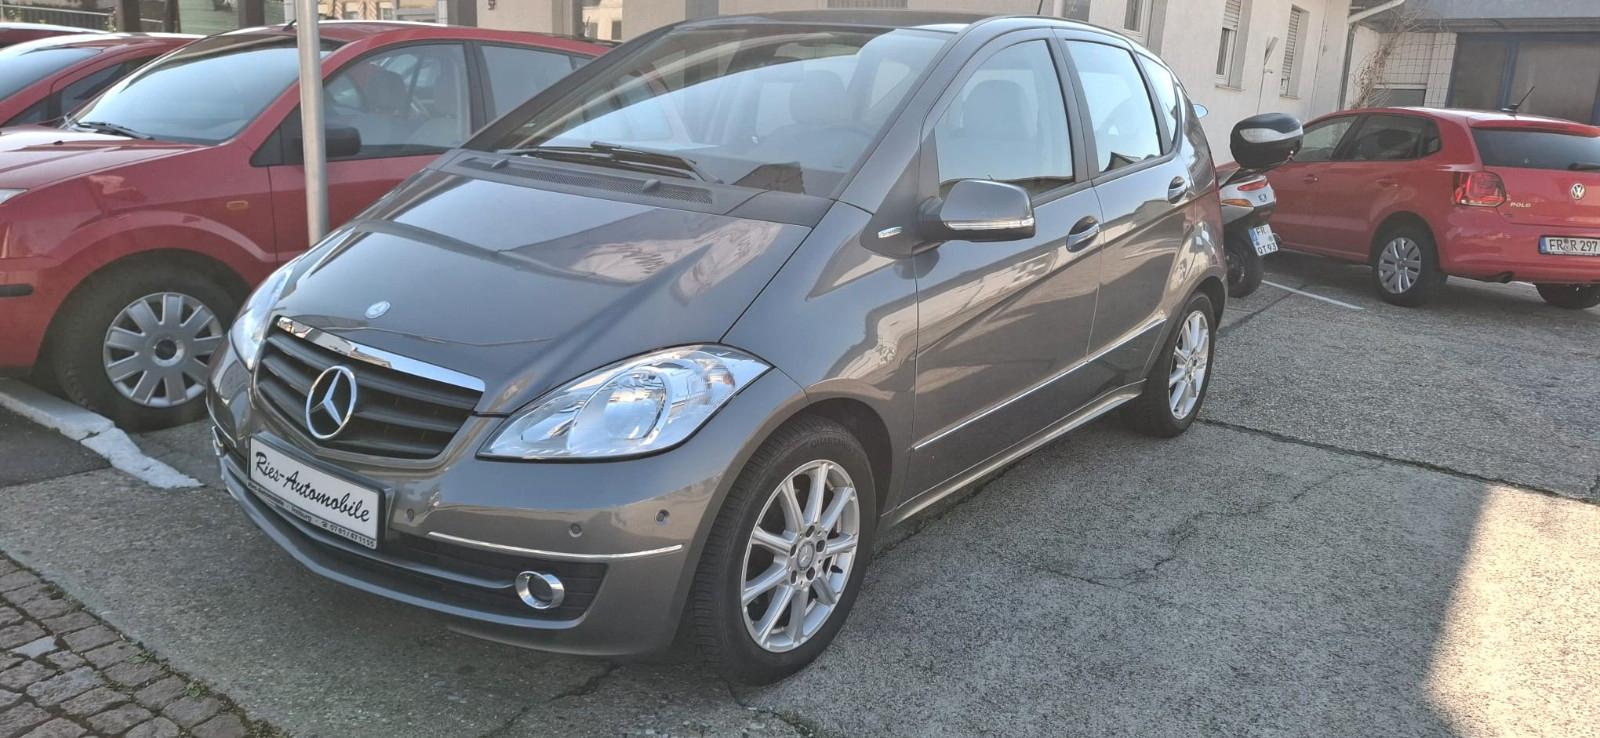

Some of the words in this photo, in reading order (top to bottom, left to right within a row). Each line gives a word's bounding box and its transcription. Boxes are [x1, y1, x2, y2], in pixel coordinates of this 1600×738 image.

[1256, 226, 1266, 235] FR
[1549, 239, 1564, 251] FR
[1570, 240, 1578, 251] R
[1580, 240, 1598, 252] 297
[256, 451, 370, 522] Ries-Automobile
